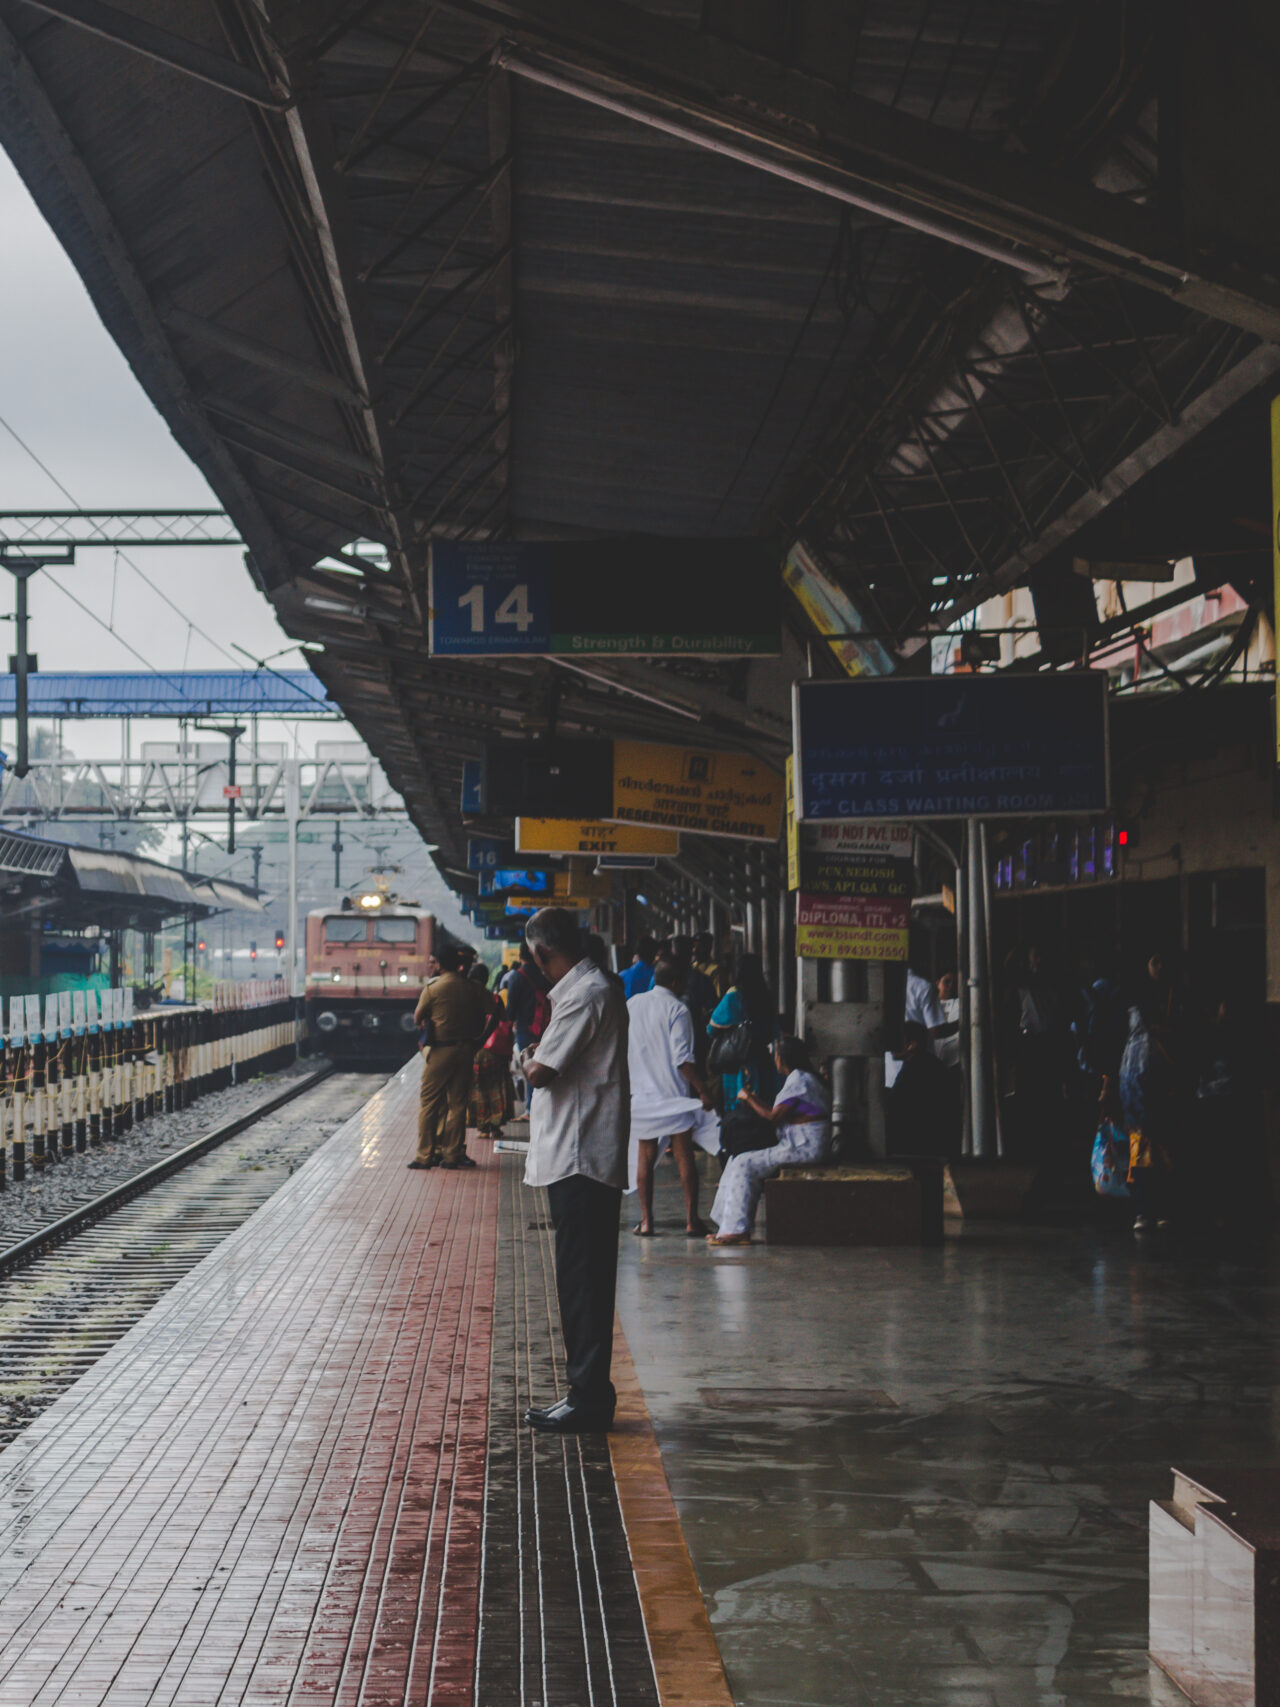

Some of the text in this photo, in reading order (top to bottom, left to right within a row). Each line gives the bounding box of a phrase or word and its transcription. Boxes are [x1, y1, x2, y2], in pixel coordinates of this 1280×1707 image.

[458, 584, 534, 633] 14
[571, 634, 753, 652] Strength & Durability
[838, 798, 900, 815] CLASS
[906, 794, 991, 813] WAITING
[997, 793, 1053, 810] ROOM
[616, 806, 766, 836] RESERVATION CHARTS
[578, 841, 617, 851] EXIT
[475, 850, 497, 866] 16
[800, 911, 862, 927] DIPLOMA,
